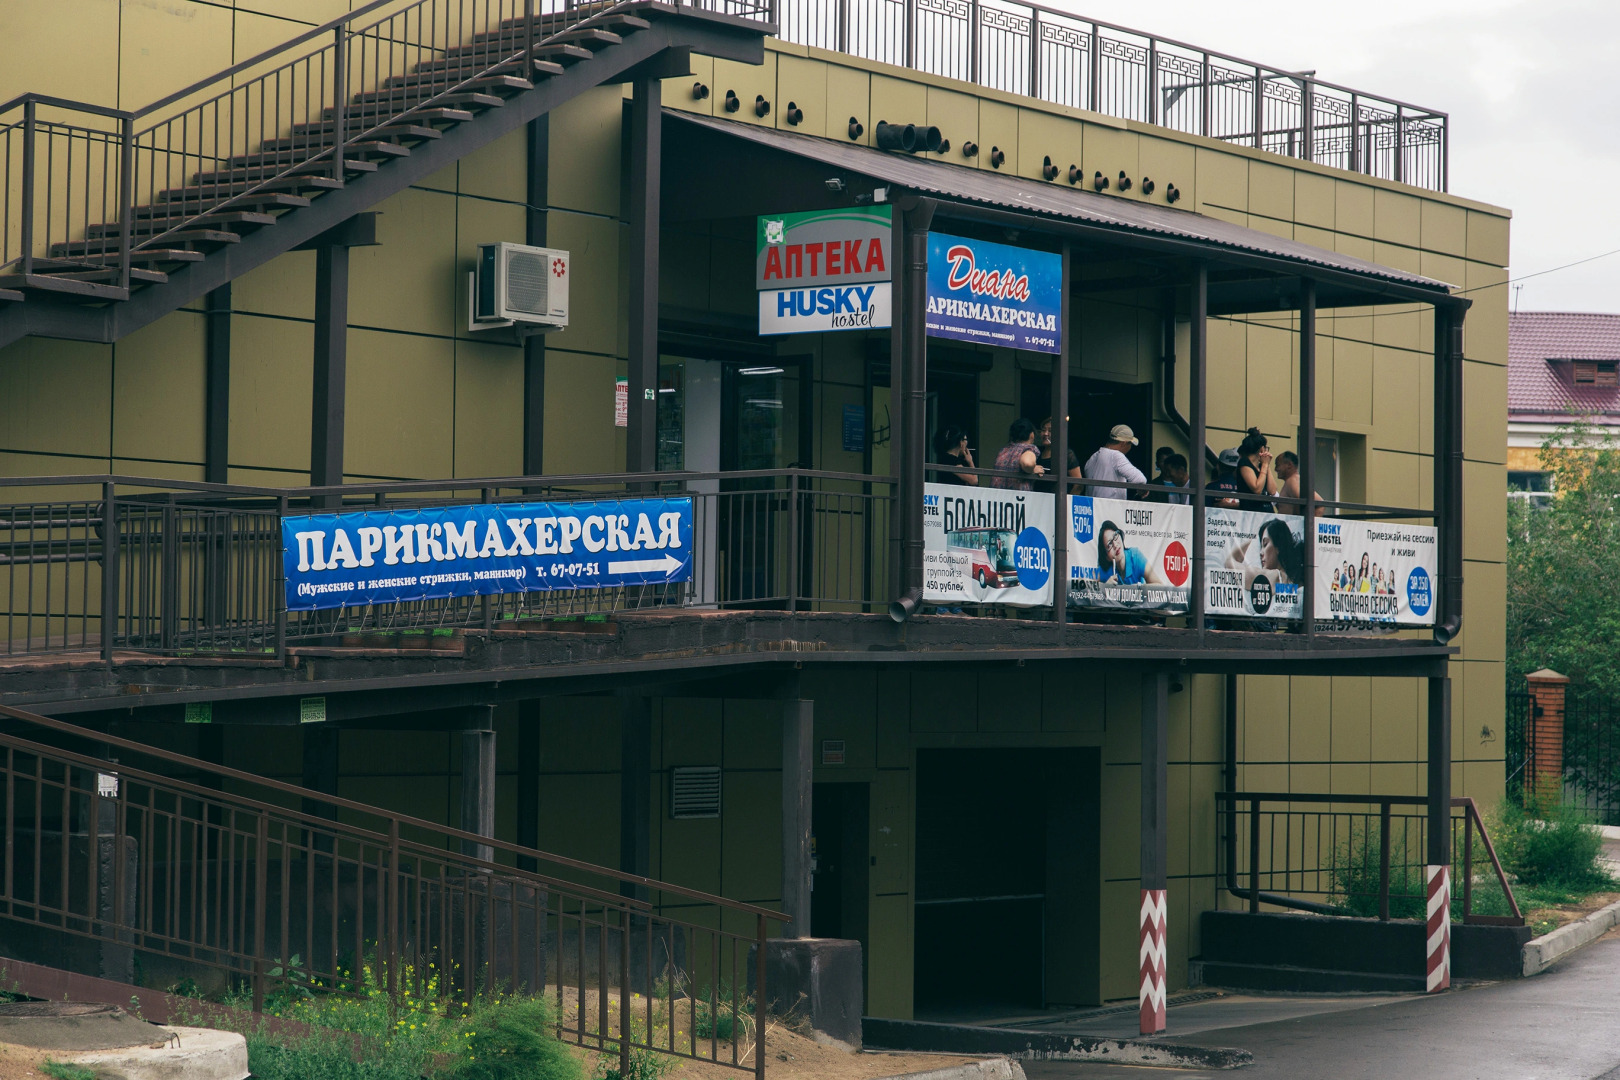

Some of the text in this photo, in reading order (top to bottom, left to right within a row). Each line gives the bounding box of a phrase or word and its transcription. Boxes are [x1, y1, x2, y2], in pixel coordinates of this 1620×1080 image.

[763, 238, 886, 281] АПТЕКА
[946, 245, 1030, 302] Диана
[777, 285, 876, 318] HUSKY
[831, 304, 876, 329] hostel
[926, 296, 1056, 332] АРИКМАХЕРСКАЯ
[945, 325, 967, 334] женские
[1024, 336, 1031, 344] т.
[1031, 337, 1055, 347] 67-07-51
[924, 495, 939, 506] SKY
[924, 507, 940, 516] STEL
[944, 497, 1026, 534] БОЛЬШОЙ
[1126, 509, 1153, 527] СТУДЕНТ
[1074, 517, 1091, 534] 50%
[1318, 524, 1342, 535] HUSKY
[1208, 530, 1221, 538] рейс
[1318, 536, 1342, 545] HOSTEL
[1368, 530, 1435, 545] Приезжай на сессию
[295, 511, 682, 573] ПАРИКМАХЕРСКАЯ
[938, 554, 969, 565] большой
[1018, 546, 1049, 573] ЗАЕЗД
[1166, 556, 1180, 572] 7500
[297, 562, 600, 597] (Мужские и женские стрижки, маникюр) т. 67-07-51
[926, 568, 955, 579] группой
[1072, 566, 1099, 579] HUSKY
[926, 582, 938, 590] 450
[1276, 583, 1299, 594] HUSKY
[1410, 576, 1428, 591] ЗА 350
[1106, 589, 1121, 601] ЖИВИ
[1120, 589, 1144, 603] ДОЛЬШЕ
[1148, 590, 1168, 603] ПЛАТИ
[1210, 587, 1244, 609] ОПЛАТА
[1258, 593, 1265, 605] 99
[1276, 595, 1298, 604] HOSTEL
[1410, 593, 1429, 607] РУБЛЕЙ
[1330, 593, 1399, 616] ВЫГОДНАЯ СЕССИЯ
[1314, 624, 1336, 632] (9244)
